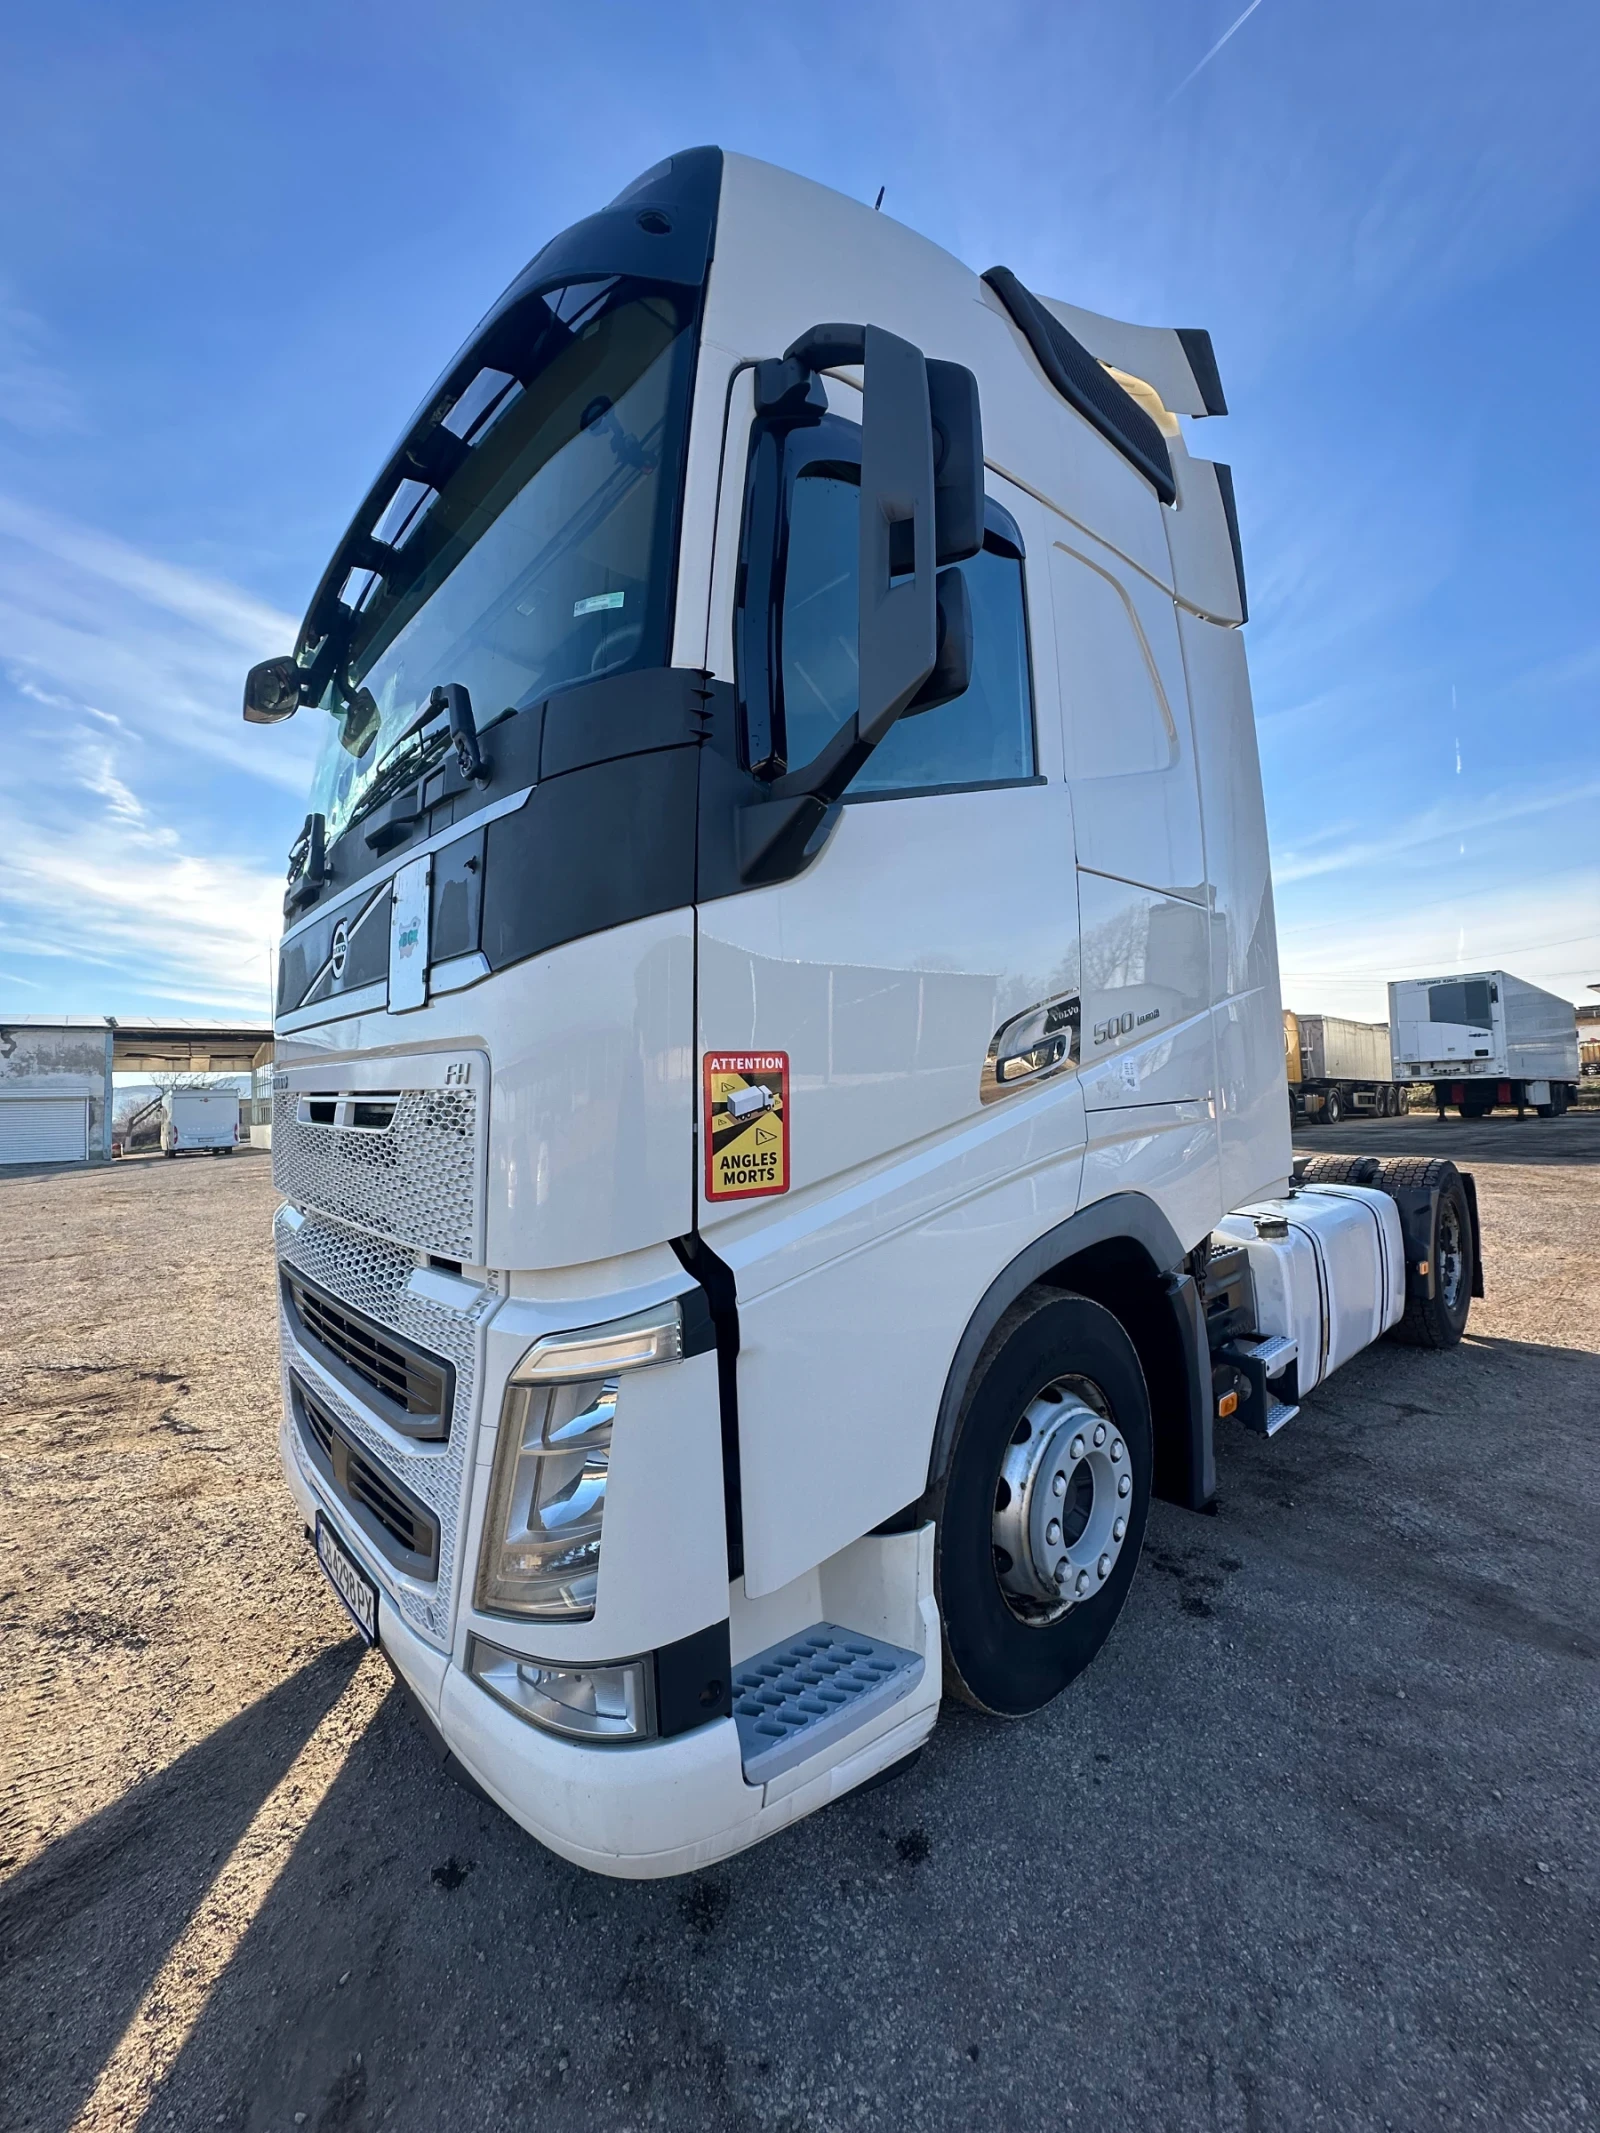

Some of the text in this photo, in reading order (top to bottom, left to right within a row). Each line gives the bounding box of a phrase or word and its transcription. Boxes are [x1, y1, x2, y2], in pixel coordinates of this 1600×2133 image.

[1052, 1006, 1079, 1021] VOLVO
[1094, 1010, 1134, 1045] 500
[711, 1057, 783, 1070] ATTENTION
[445, 1063, 471, 1085] FH
[720, 1152, 777, 1170] ANGLES
[723, 1168, 775, 1185] MORTS
